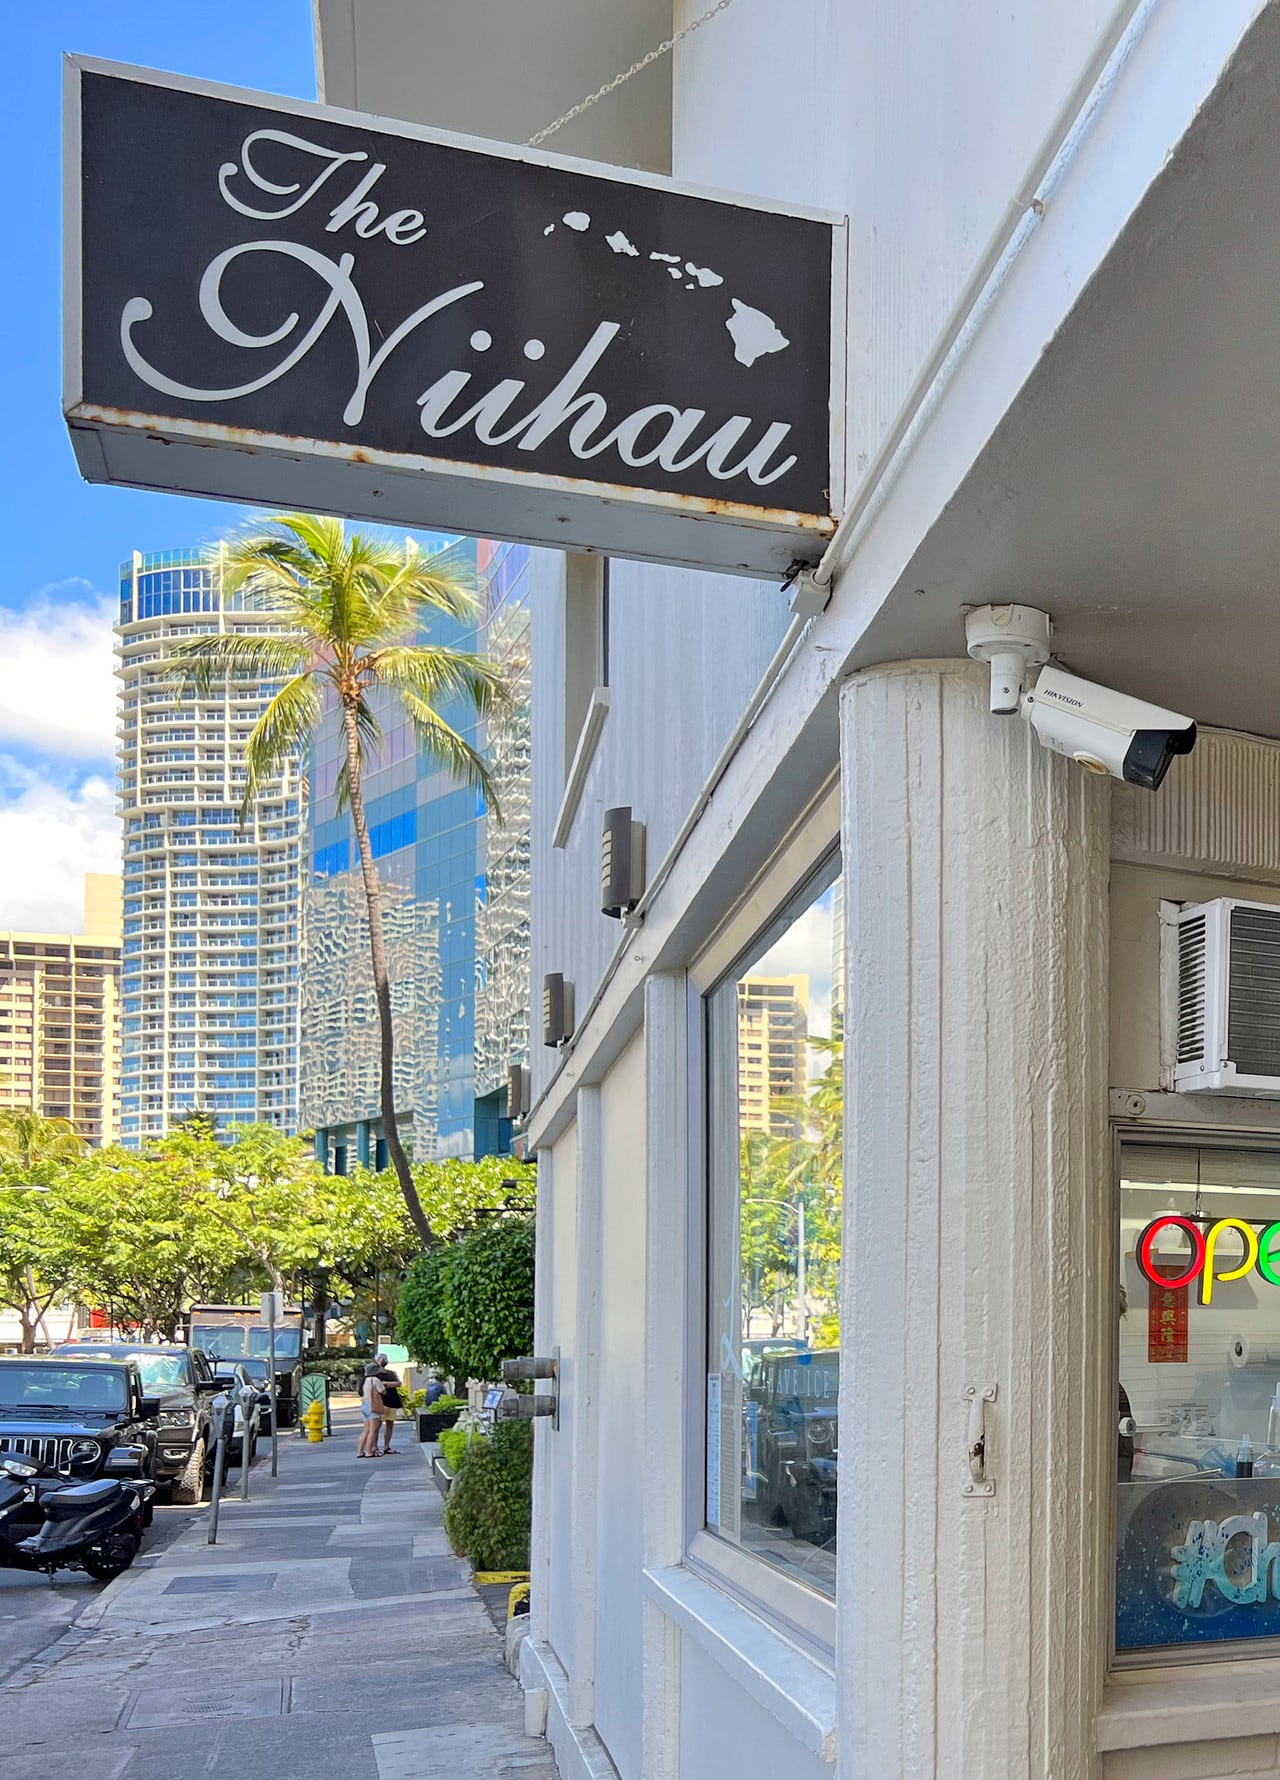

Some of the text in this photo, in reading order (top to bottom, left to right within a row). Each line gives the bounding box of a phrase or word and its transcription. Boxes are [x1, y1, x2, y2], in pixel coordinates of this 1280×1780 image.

[218, 128, 427, 245] The
[120, 240, 798, 487] Niihau
[1043, 689, 1085, 708] HIKVISION
[807, 1369, 830, 1398] ICE
